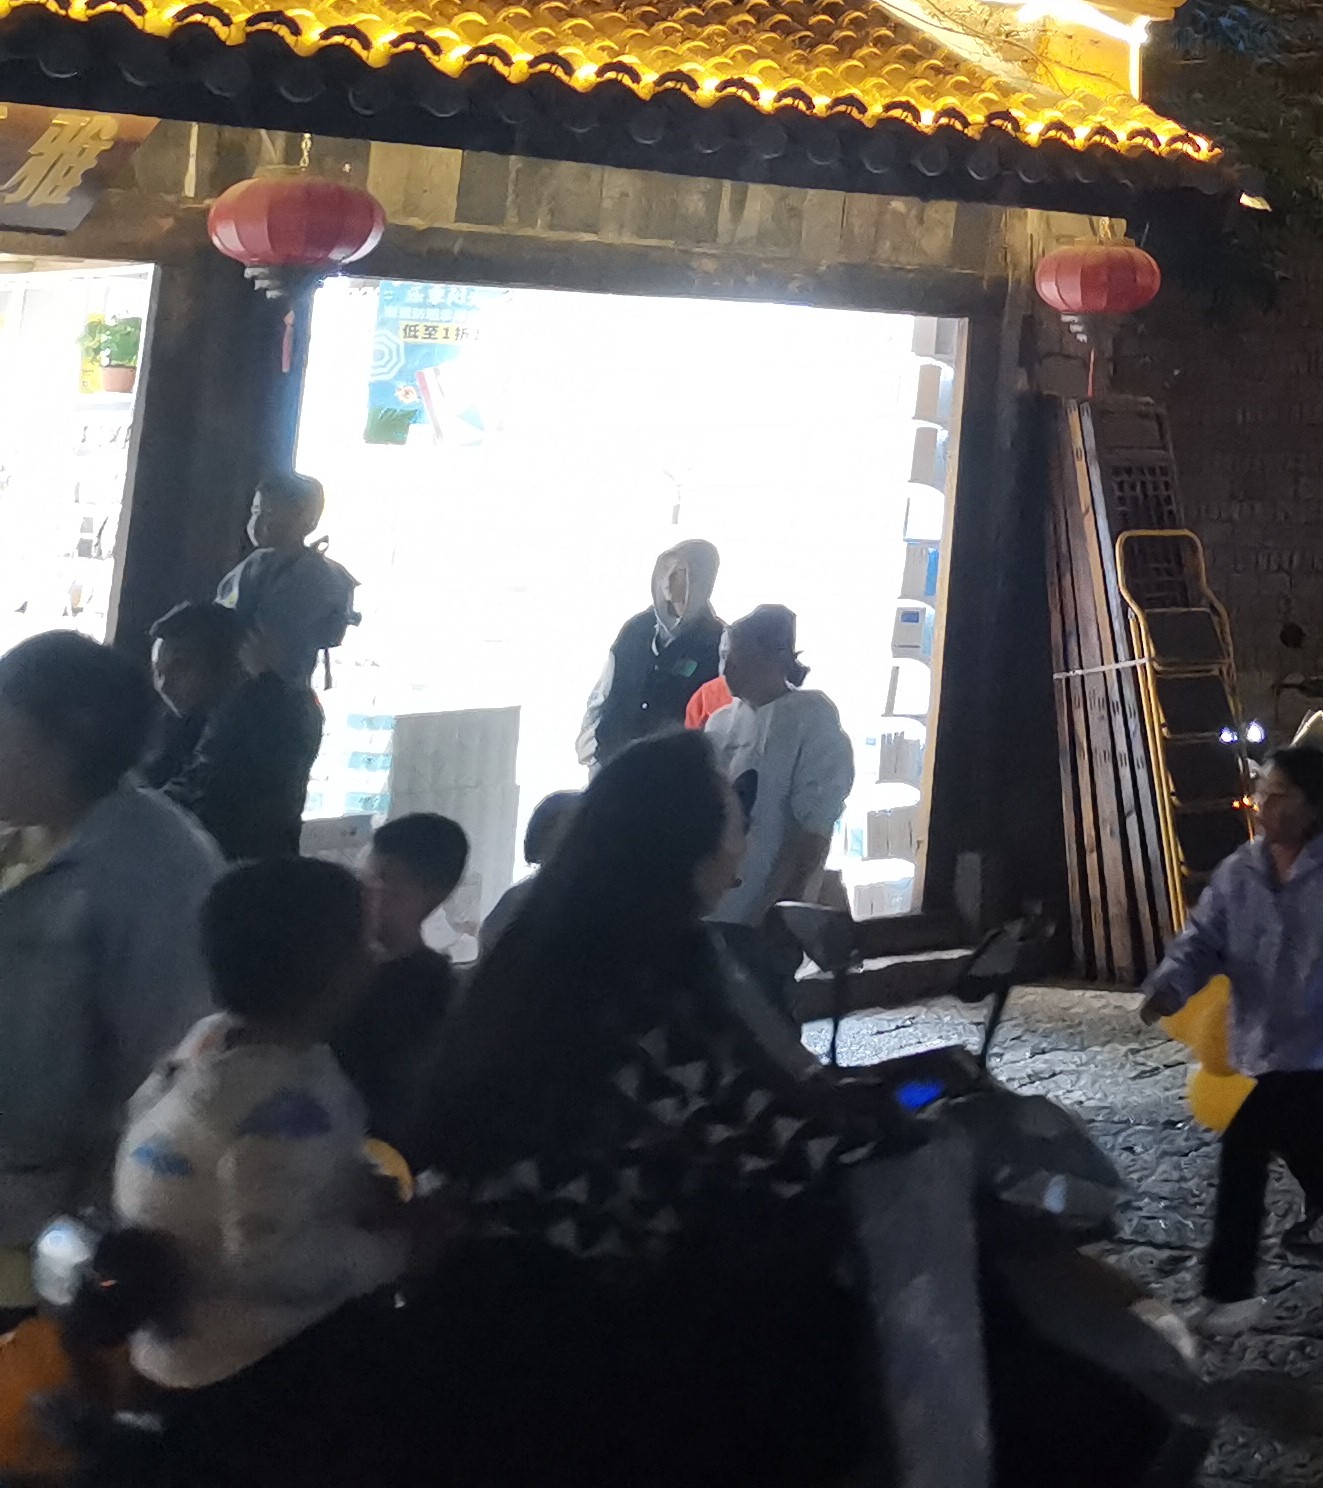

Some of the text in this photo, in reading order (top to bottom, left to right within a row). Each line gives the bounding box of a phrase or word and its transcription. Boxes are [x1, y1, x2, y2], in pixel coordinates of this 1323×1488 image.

[0, 105, 118, 207] 雅
[402, 323, 480, 341] 低至1折
